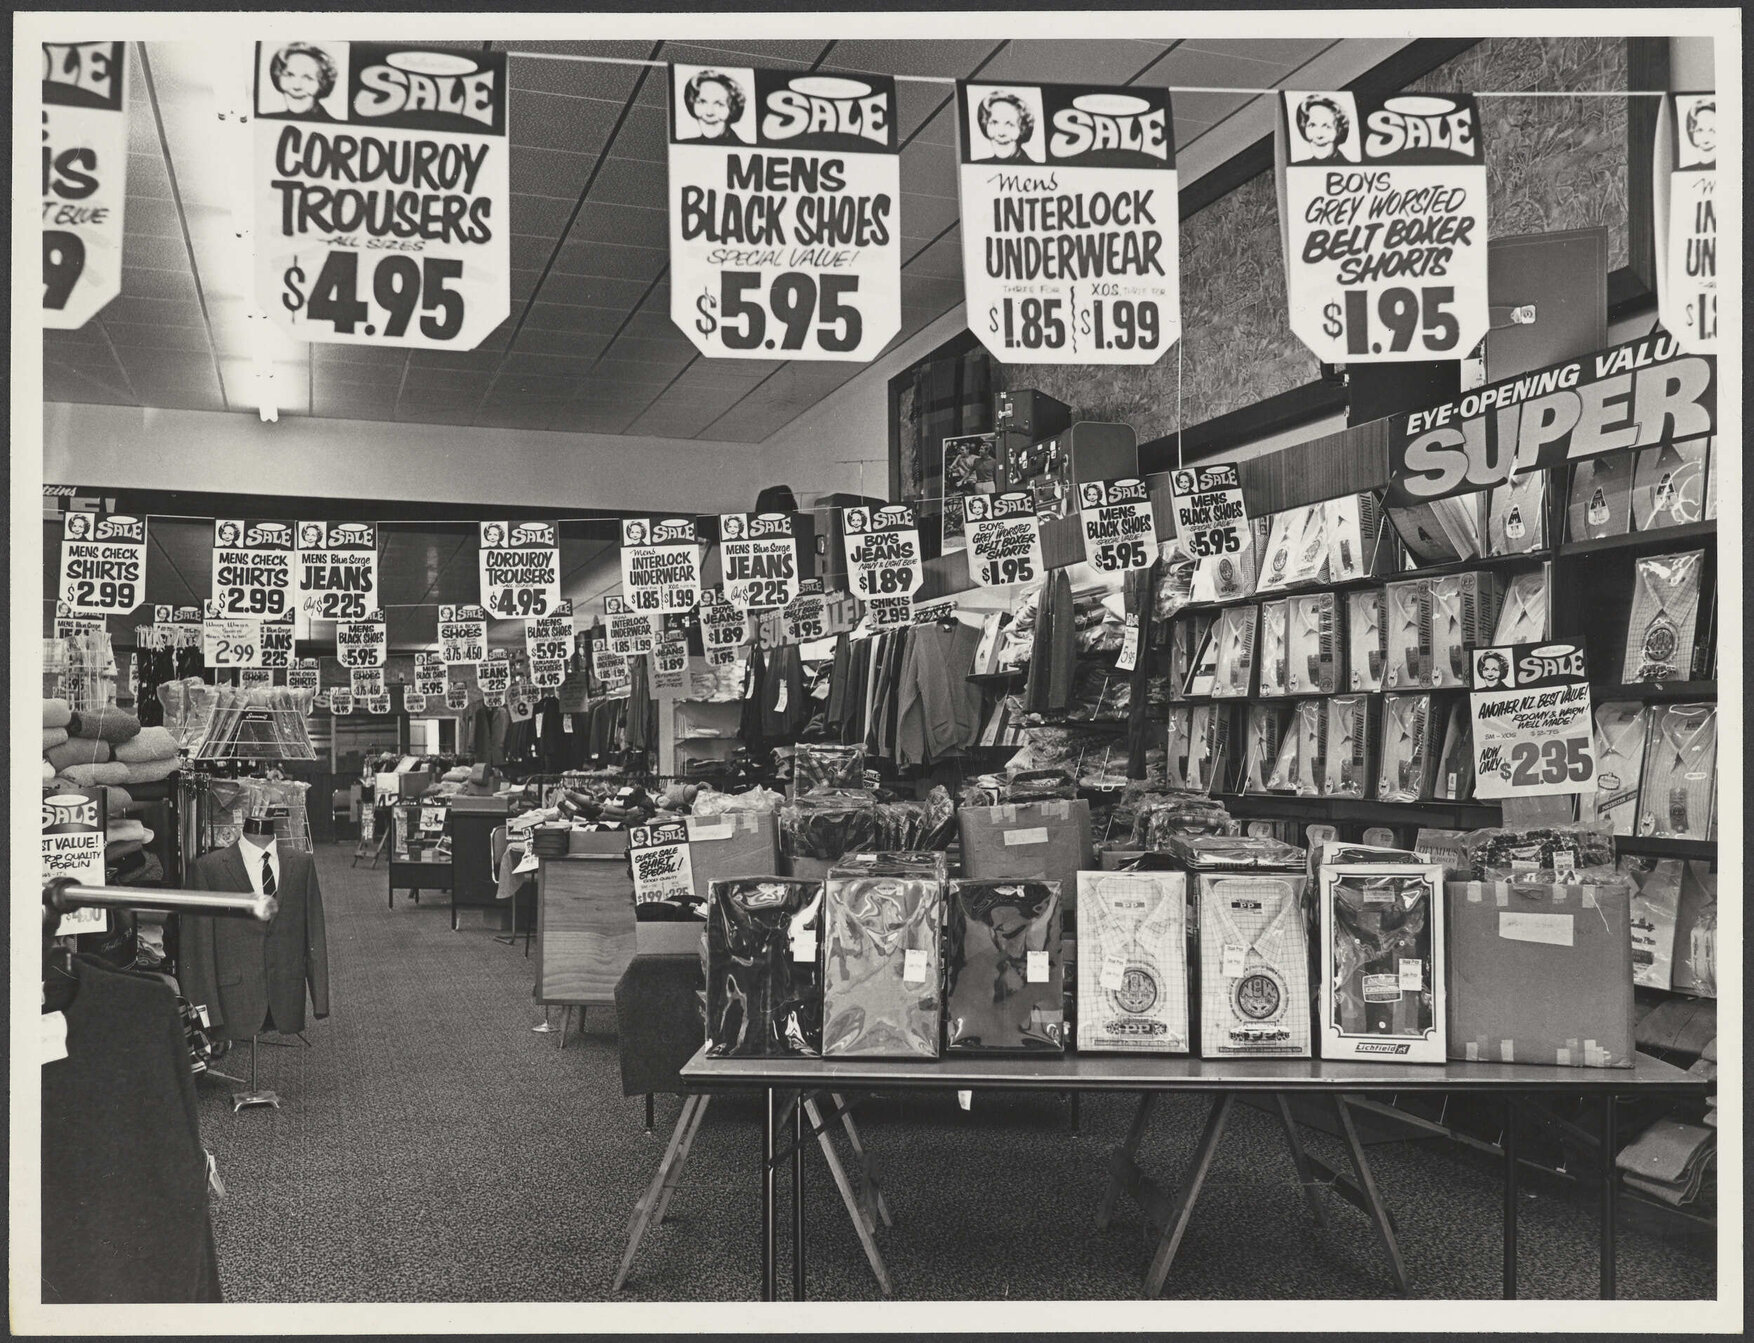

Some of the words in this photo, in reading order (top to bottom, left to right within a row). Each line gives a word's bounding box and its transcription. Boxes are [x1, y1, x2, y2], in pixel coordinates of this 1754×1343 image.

[354, 66, 493, 125] SALE
[762, 91, 888, 145] SALE
[1050, 108, 1167, 160] SALE
[1366, 107, 1475, 158] SALE
[277, 126, 489, 193] CORDUROY
[727, 154, 846, 193] MENS
[987, 173, 1058, 193] Mens
[1326, 172, 1390, 194] BOYS
[55, 205, 109, 224] BLUE
[271, 180, 492, 244] TROUSERS
[994, 190, 1156, 233] INTERLOCK
[1306, 193, 1361, 225] GREY
[1369, 185, 1467, 218] WORSTED
[681, 186, 786, 245] BLACK
[795, 194, 890, 247] SHOES
[366, 239, 426, 251] SIZES
[1302, 221, 1377, 263] BELT
[1385, 215, 1475, 253] BOXER
[706, 250, 783, 267] SPECIAL
[791, 249, 860, 268] VALUE!
[986, 231, 1165, 280] UNDERWEAR
[1337, 247, 1452, 286] SHORTS
[282, 251, 464, 340] $4.95
[696, 271, 863, 353] $5.95
[1323, 286, 1459, 356] $1.95
[989, 298, 1065, 349] $1.85
[1081, 299, 1159, 350] $1.99
[1406, 363, 1581, 436] EYE-OPENING
[1595, 335, 1682, 378] VALU
[1404, 357, 1711, 497] SUPER
[1199, 469, 1238, 491] SALE
[1108, 482, 1147, 503] SALE
[1190, 492, 1228, 508] MENS
[994, 497, 1033, 516] SALE
[1099, 505, 1136, 521] MENS
[1179, 505, 1211, 526] BLACK
[1213, 500, 1243, 521] SHOES
[750, 517, 792, 537] SALE
[873, 509, 914, 530] SALE
[979, 522, 1004, 532] BOYS
[1087, 519, 1117, 539] BLACK
[1122, 513, 1152, 534] SHOES
[1361, 495, 1374, 540] whitmont
[96, 521, 143, 541] SALE
[246, 528, 292, 548] SALE
[328, 528, 374, 548] SALE
[510, 526, 555, 546] SALE
[652, 523, 695, 543] SALE
[864, 533, 899, 547] BOYS
[973, 531, 994, 545] GREY
[999, 523, 1031, 540] WORSTED
[726, 544, 750, 555] MENS
[753, 543, 769, 554] Blue
[770, 543, 791, 555] Serge
[975, 539, 1001, 555] BELT
[1003, 533, 1035, 547] BOXER
[987, 544, 1031, 560] SHORTS
[1189, 527, 1240, 557] $5.95
[69, 545, 98, 558] MENS
[102, 547, 139, 560] CHECK
[219, 552, 248, 565] MENS
[251, 554, 288, 567] CHECK
[302, 553, 327, 564] MENS
[330, 554, 348, 564] Blue
[349, 554, 370, 567] Serge
[486, 551, 553, 568] CORDUROY
[632, 551, 691, 570] INTERLOCK
[850, 542, 914, 563] JEANS
[1095, 541, 1146, 571] $5.95
[66, 559, 139, 581] SHIRTS
[217, 566, 289, 587] SHIRTS
[485, 568, 555, 586] TROUSERS
[630, 565, 695, 586] UNDERWEAR
[726, 554, 794, 581] JEANS
[982, 557, 1033, 585] $1.95
[300, 566, 373, 592] JEANS
[859, 567, 913, 594] $1.89
[68, 581, 135, 608] $2.99
[219, 588, 285, 614] $2.99
[490, 588, 547, 616] $4.95
[632, 590, 660, 609] $1.85
[664, 589, 694, 608] $1.99
[173, 610, 202, 622] SALE
[457, 608, 484, 620] SALE
[703, 611, 744, 624] JEANS
[712, 606, 734, 615] BOYS
[873, 608, 910, 624] $2.99
[1462, 592, 1475, 640] whitmont
[348, 625, 374, 633] MENS
[528, 627, 550, 639] BLACK
[551, 625, 572, 637] SHOES
[536, 618, 563, 626] MENS
[610, 625, 652, 638] UNDERWEAR
[612, 616, 649, 629] INTERLOCK
[788, 620, 822, 638] $1.95
[339, 632, 361, 644] BLACK
[363, 631, 384, 643] SHOES
[442, 628, 482, 639] SHOES
[709, 627, 743, 644] $1.89
[216, 640, 254, 663] 2.99
[342, 648, 378, 666] $5.95
[531, 642, 568, 659] $5.95
[655, 646, 684, 657] JEANS
[479, 667, 508, 679] JEANS
[1518, 649, 1585, 684] SALE
[1478, 698, 1518, 720] ANOTHER
[1537, 690, 1562, 708] BEST
[1560, 685, 1589, 703] VALUE!
[1512, 711, 1549, 722] ROOMY
[1518, 720, 1540, 729] WELL
[1542, 714, 1575, 728] MADE!
[1479, 757, 1502, 775] ONLY
[1500, 737, 1593, 786] $2.35
[1480, 745, 1502, 762] NOW
[42, 800, 98, 829] SALE
[55, 834, 99, 850] VALUE!
[653, 828, 686, 845] SALE
[50, 860, 91, 869] POPLIN
[64, 851, 102, 863] QUALITY
[635, 850, 657, 864] SUPER
[658, 847, 678, 858] SALE
[639, 855, 674, 872] SHIRT
[639, 857, 684, 880] SPECIAL!
[1356, 1043, 1397, 1052] Lichfield
